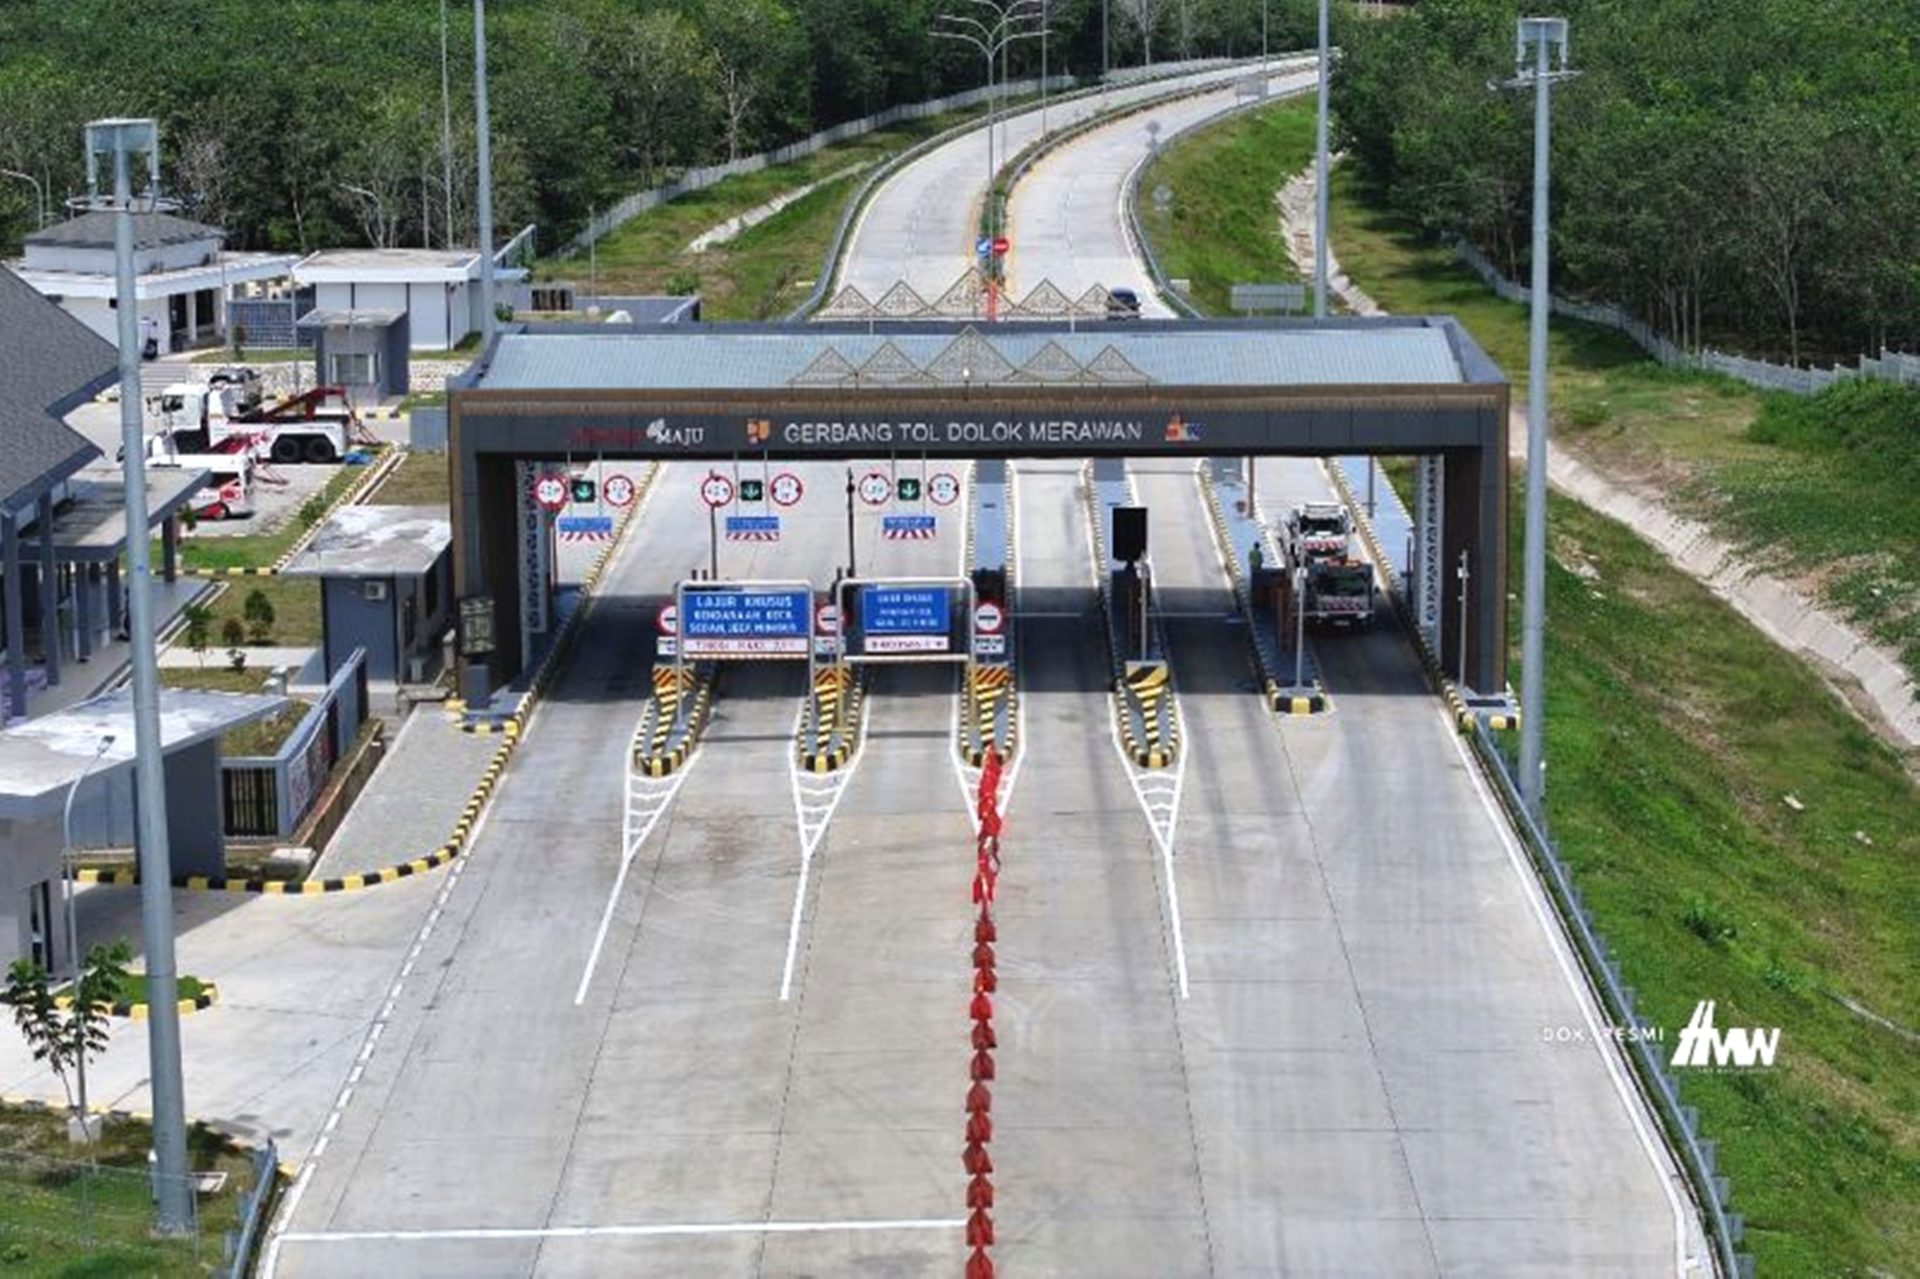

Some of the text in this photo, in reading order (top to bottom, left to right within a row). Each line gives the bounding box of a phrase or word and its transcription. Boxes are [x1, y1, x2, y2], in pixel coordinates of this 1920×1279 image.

[655, 427, 704, 446] MAJU
[783, 422, 893, 443] GERBANG
[898, 423, 941, 442] TOL
[947, 422, 1023, 442] DOLOK
[1029, 421, 1143, 441] MERAWAN
